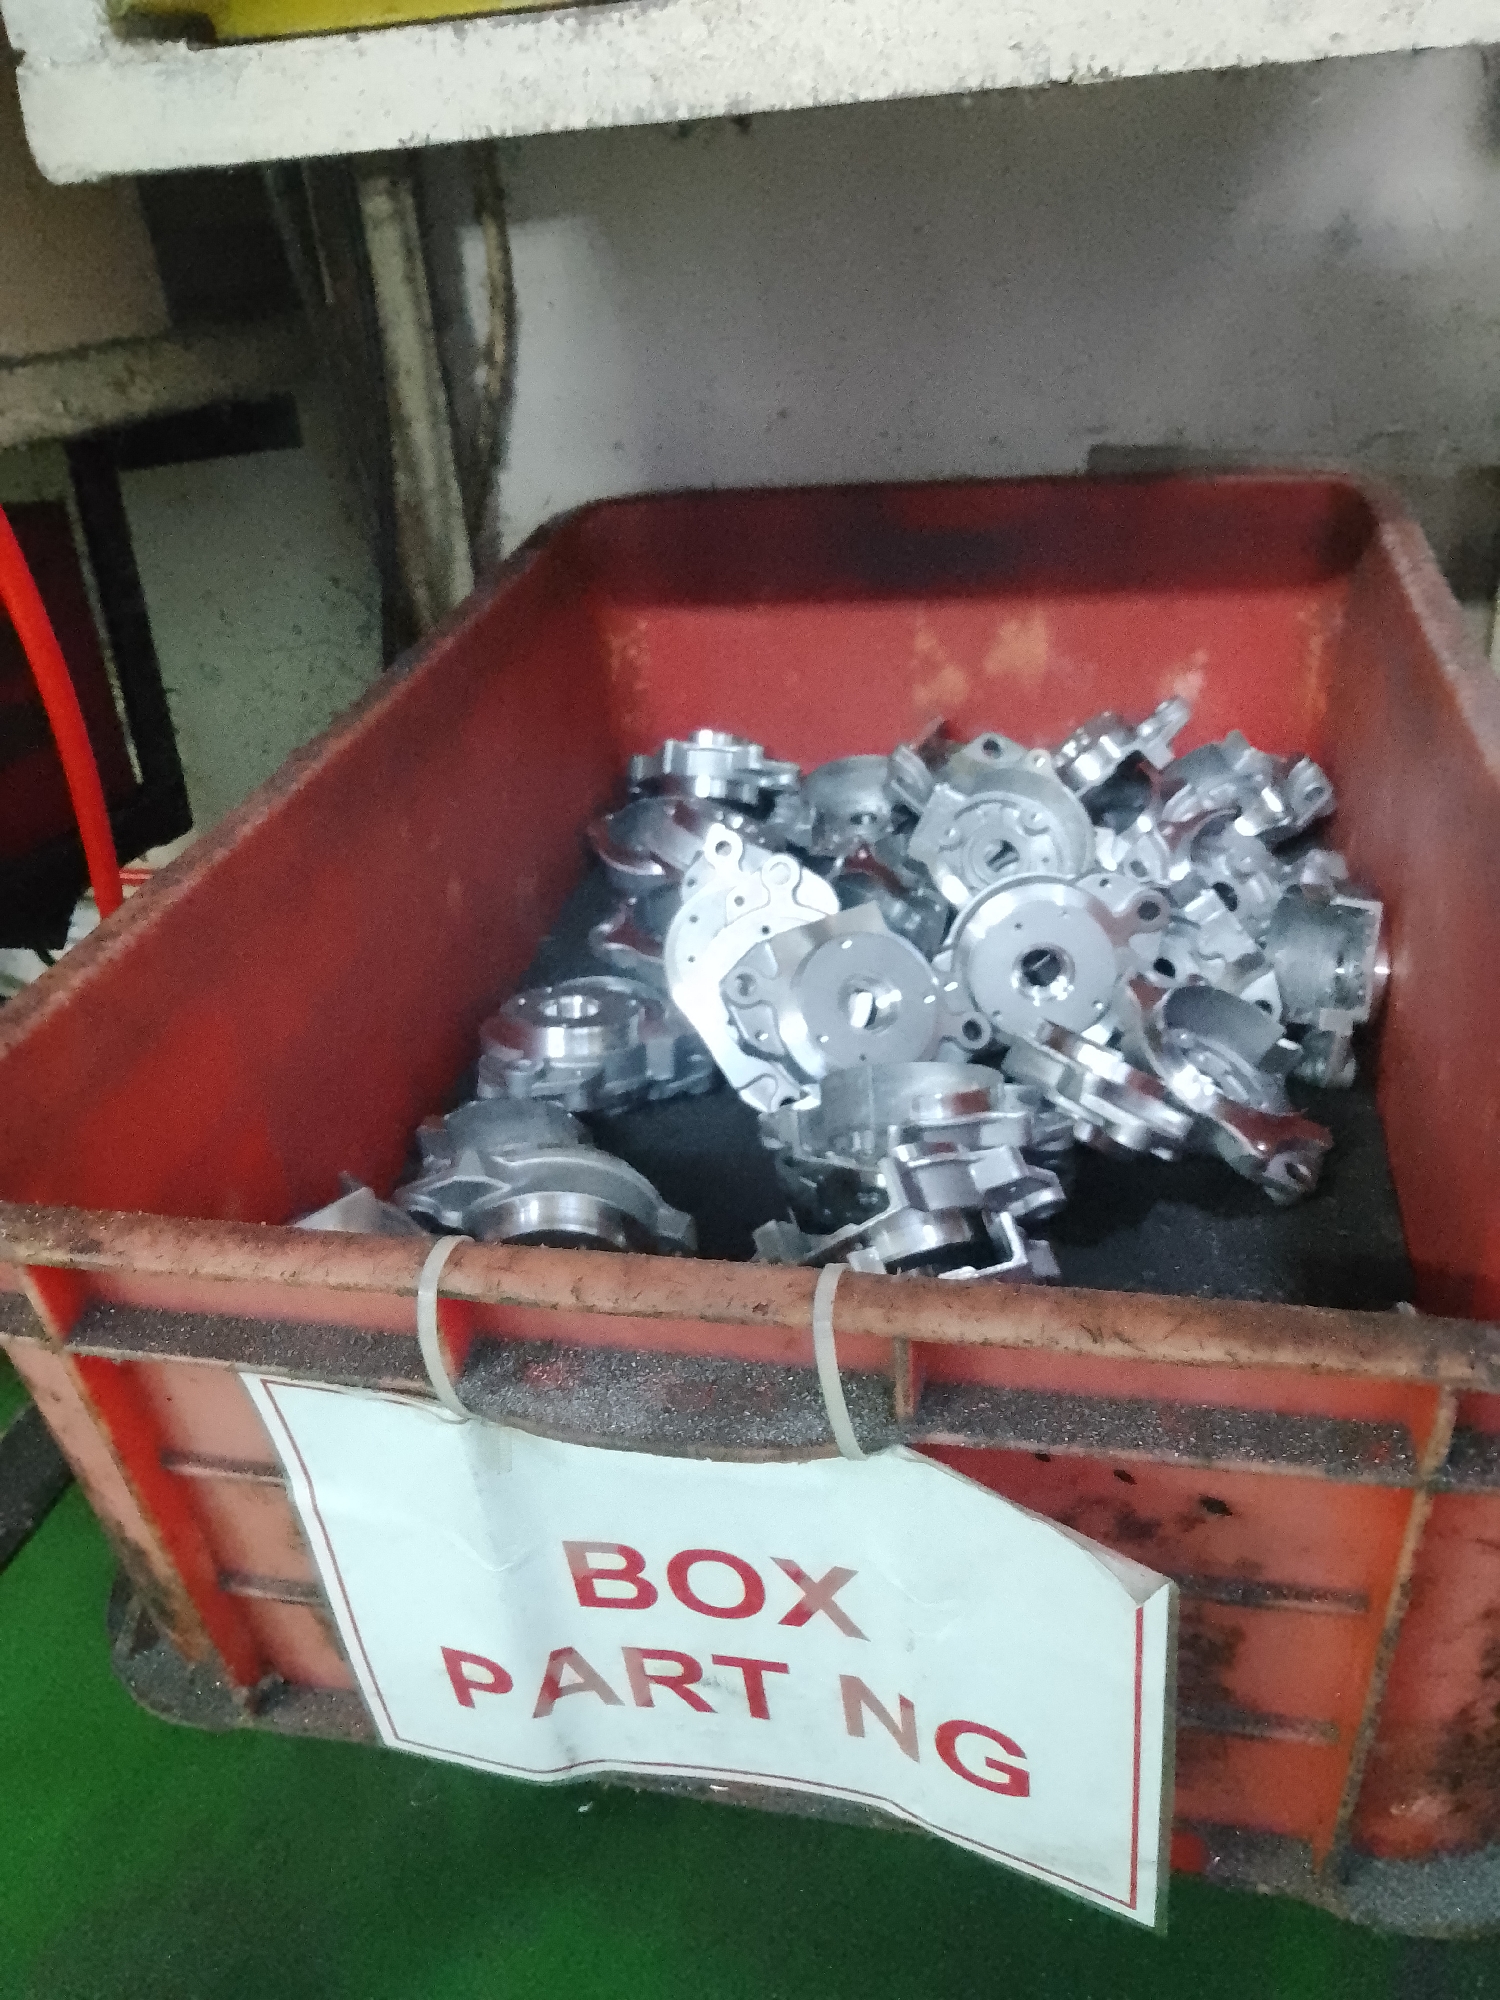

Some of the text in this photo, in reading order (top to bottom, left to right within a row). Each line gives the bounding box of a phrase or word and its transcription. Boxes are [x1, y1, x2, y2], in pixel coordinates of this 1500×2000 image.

[562, 1540, 870, 1641] BOX
[440, 1646, 1030, 1798] PART NG
